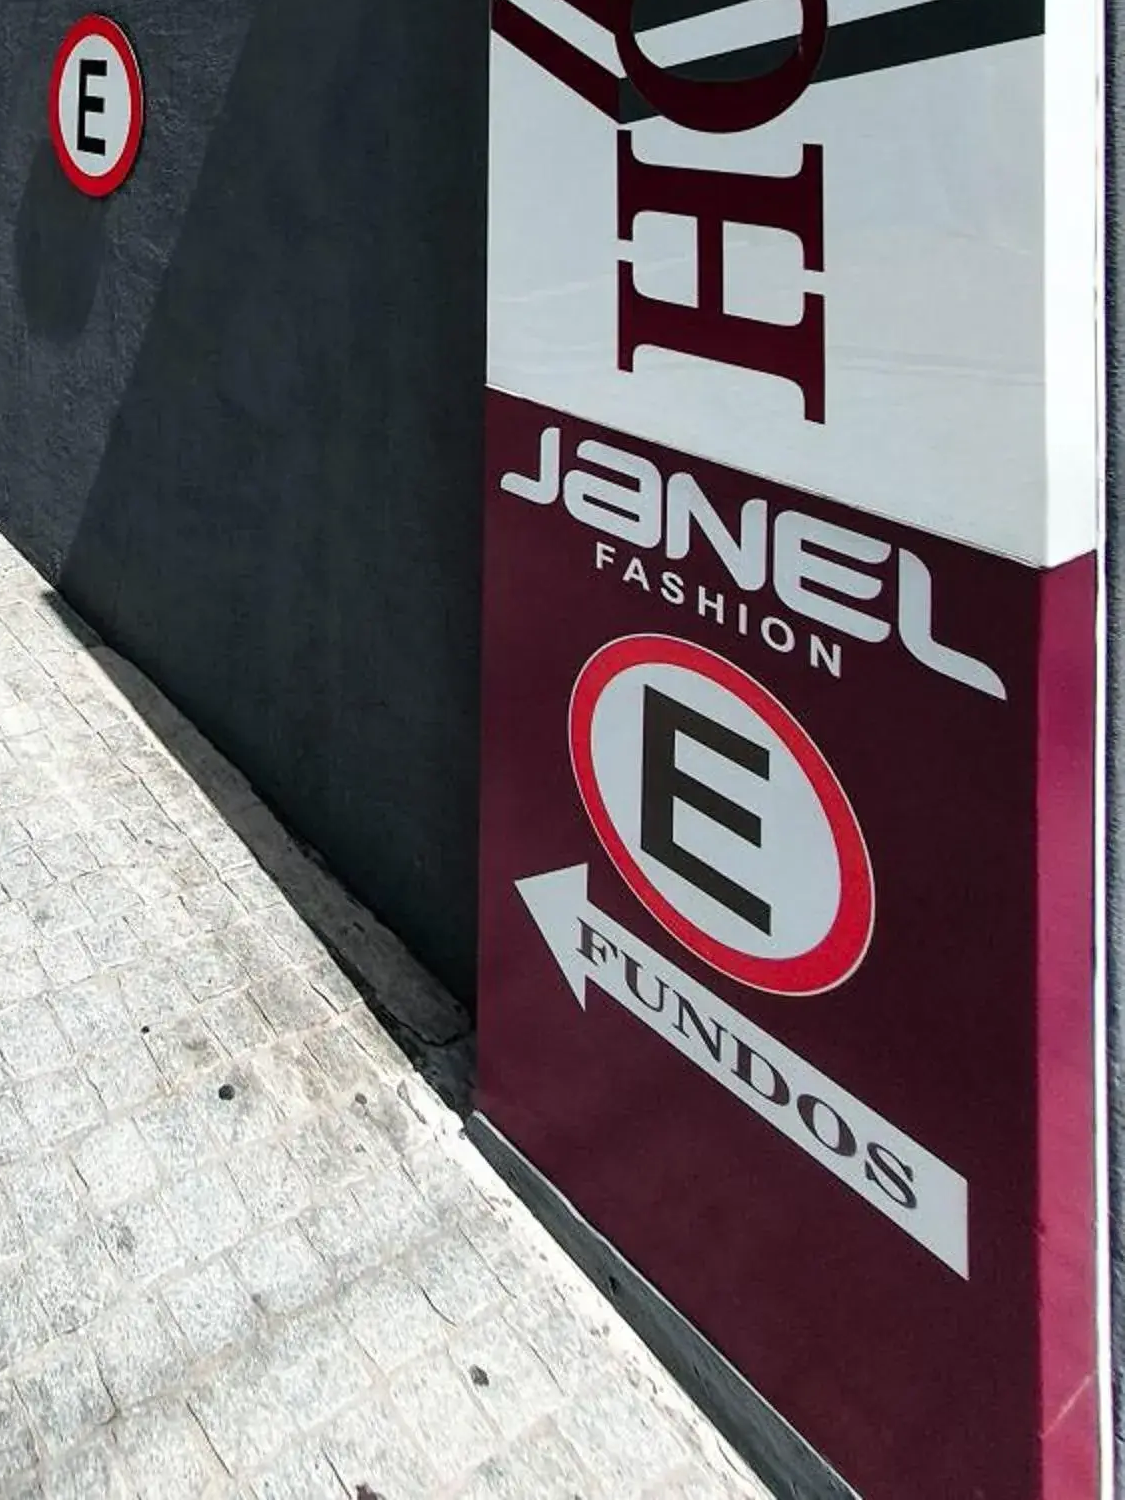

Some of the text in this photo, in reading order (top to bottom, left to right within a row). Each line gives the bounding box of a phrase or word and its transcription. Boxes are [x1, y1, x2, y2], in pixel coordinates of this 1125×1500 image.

[77, 59, 107, 155] E
[595, 542, 843, 678] FASHION
[640, 682, 772, 937] E
[576, 915, 918, 1210] FUNDOS
